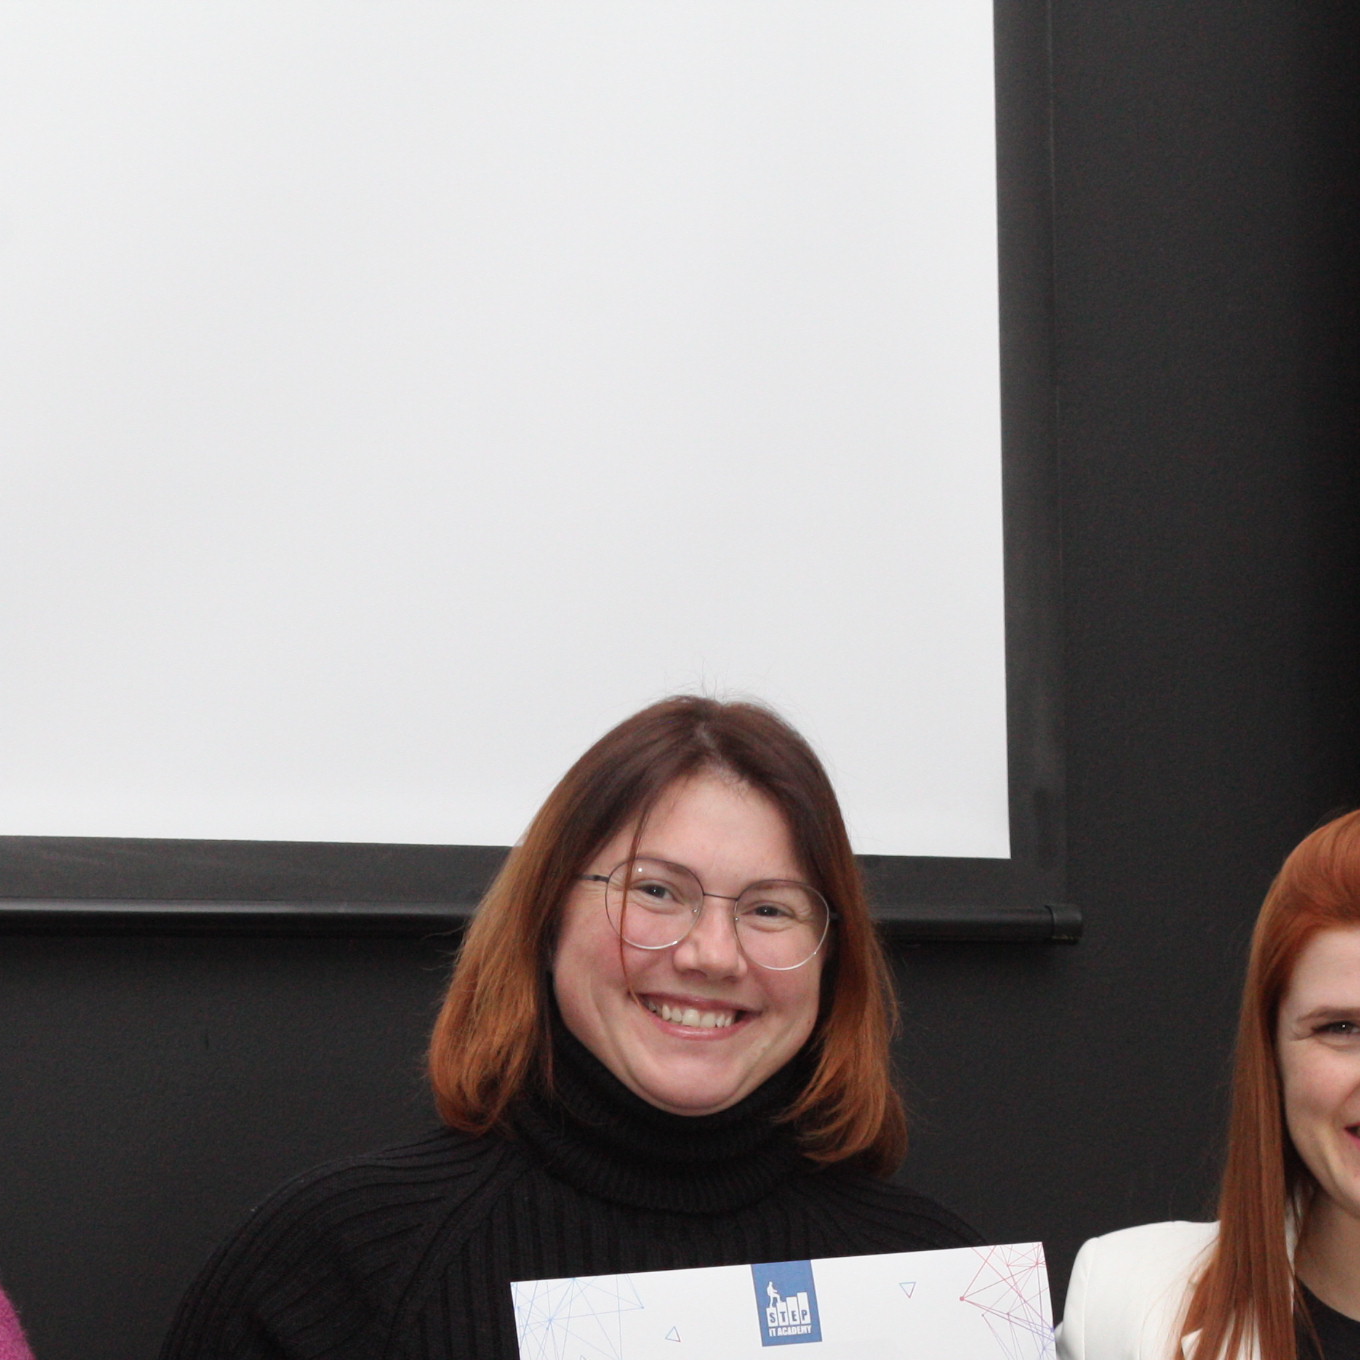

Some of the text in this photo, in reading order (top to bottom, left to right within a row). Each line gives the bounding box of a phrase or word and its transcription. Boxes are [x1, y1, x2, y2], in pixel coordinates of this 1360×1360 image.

[768, 1309, 808, 1323] STEP
[768, 1325, 812, 1337] IT ACADEMY
